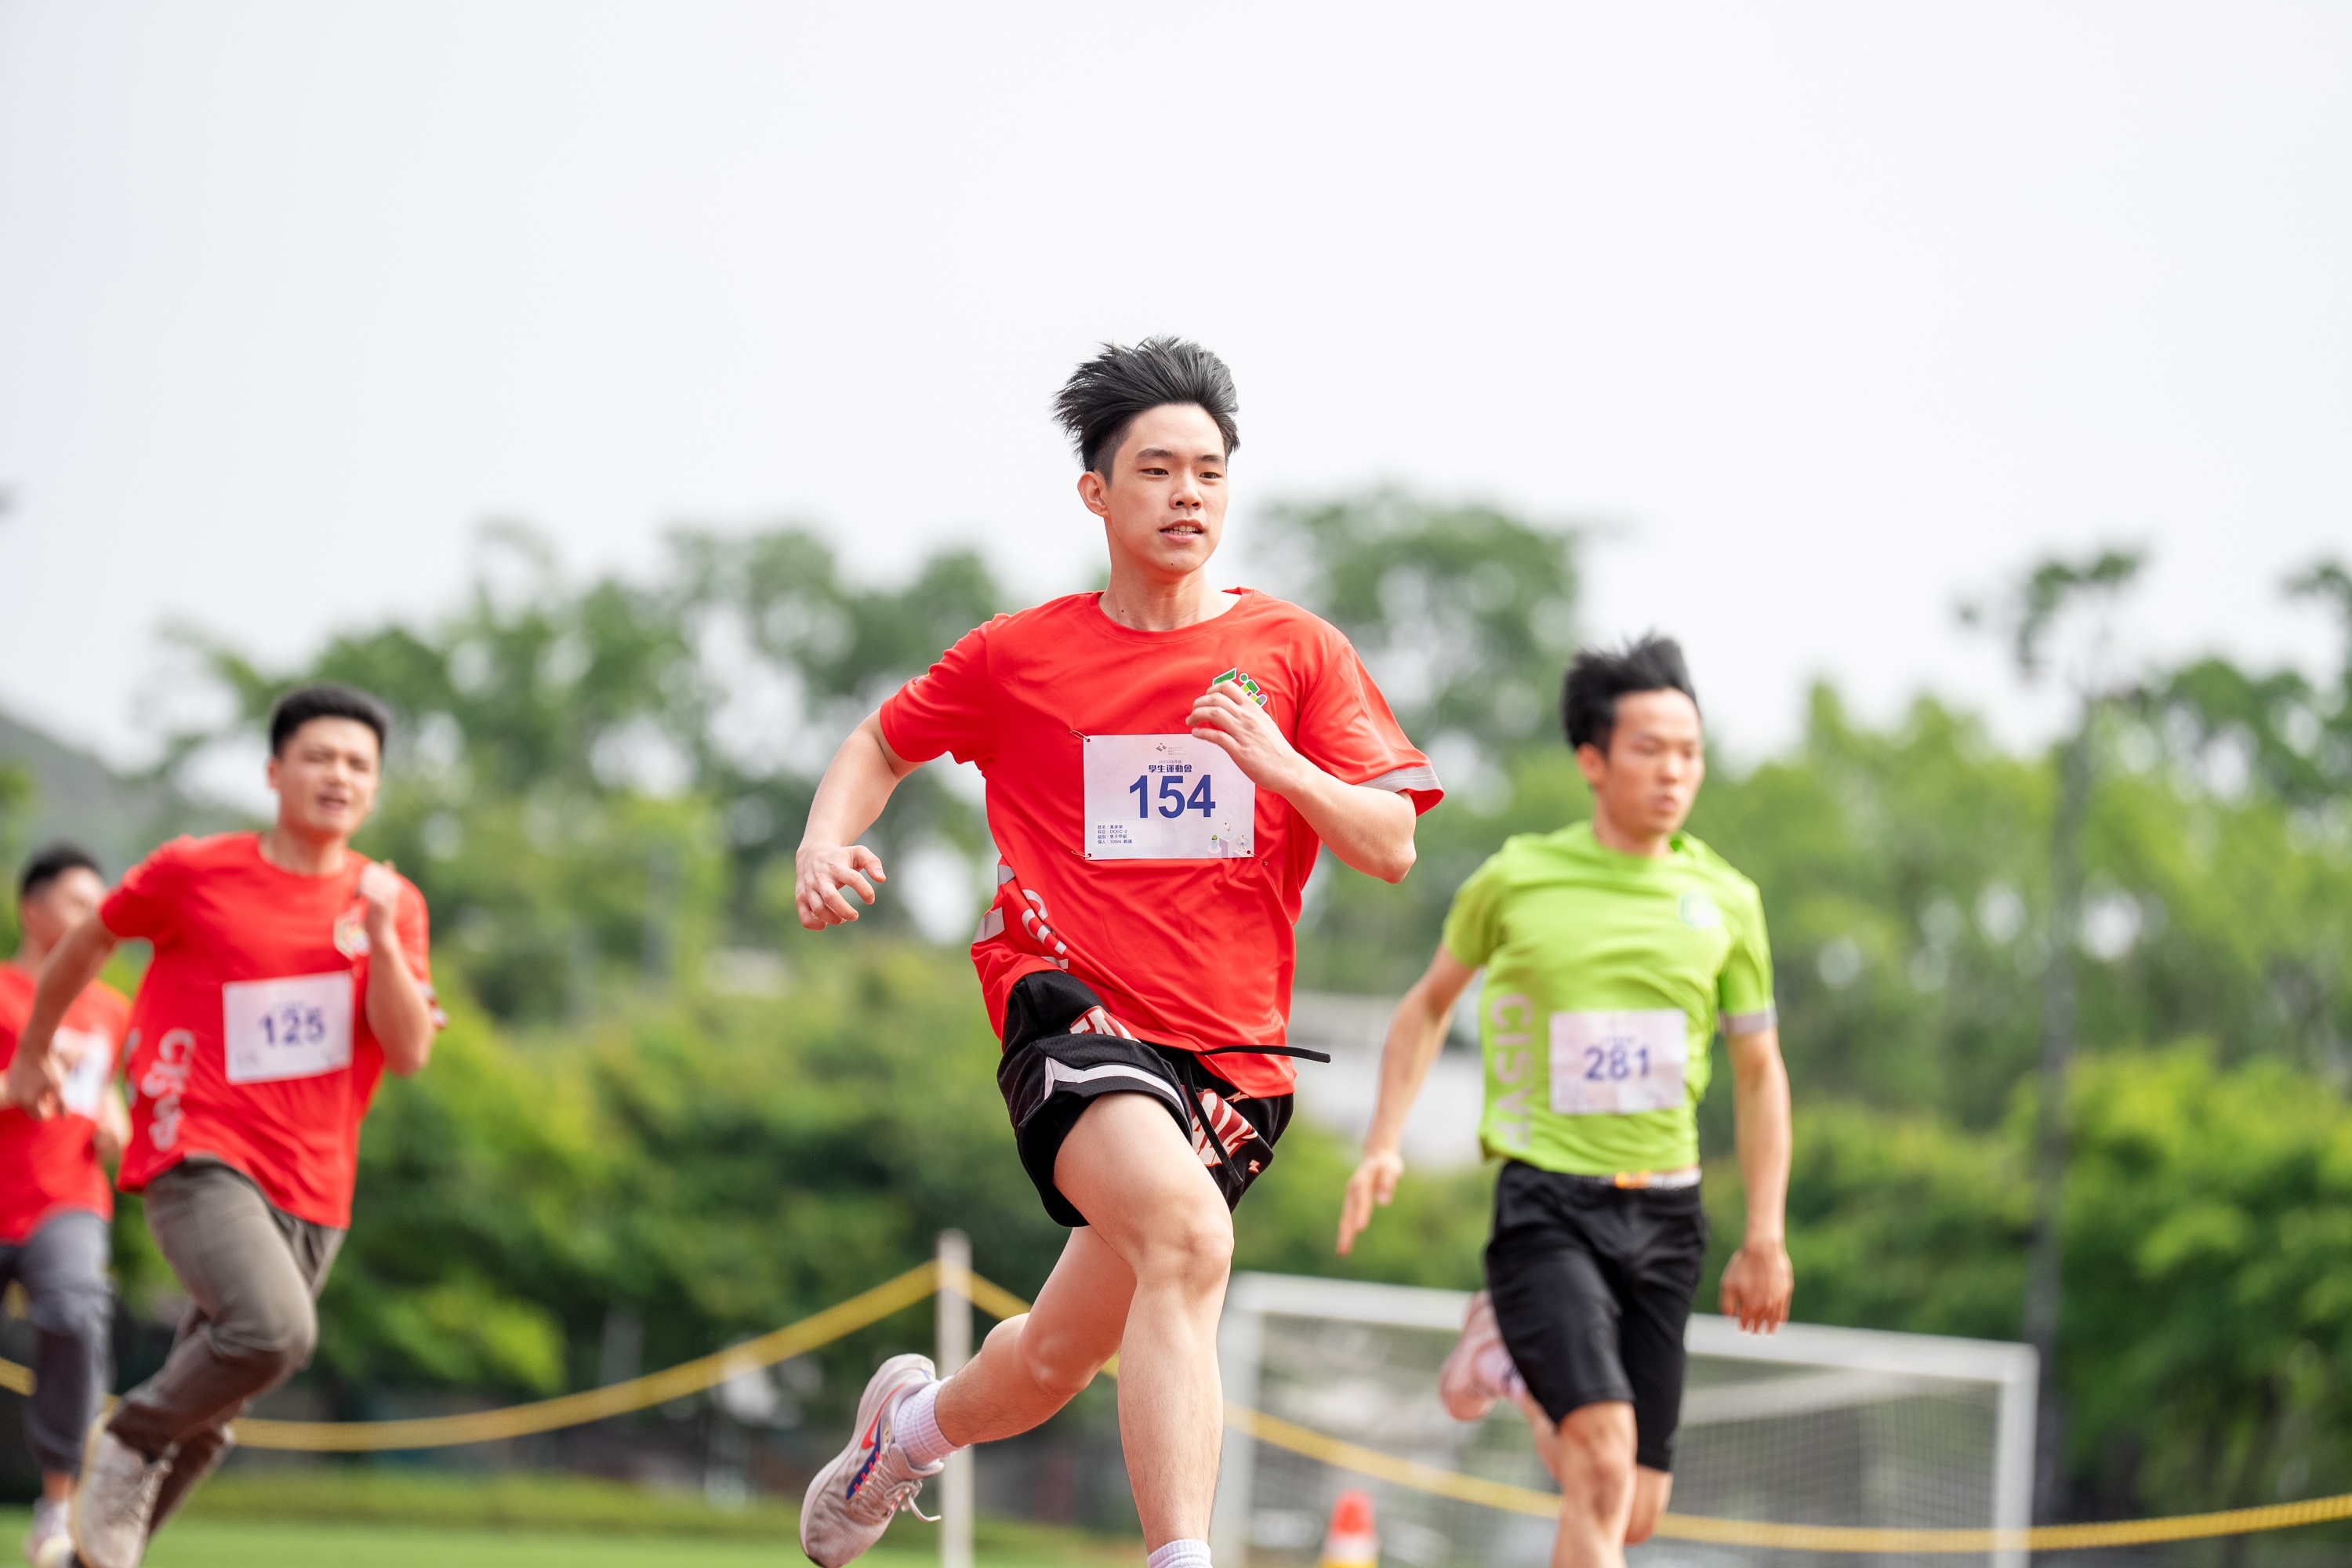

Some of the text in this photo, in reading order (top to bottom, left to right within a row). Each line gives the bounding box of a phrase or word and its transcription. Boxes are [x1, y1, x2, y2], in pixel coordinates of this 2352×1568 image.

[1148, 764, 1192, 773] 學生運動會
[1130, 775, 1216, 818] 154
[258, 1006, 326, 1047] 125
[1584, 1045, 1650, 1081] 281
